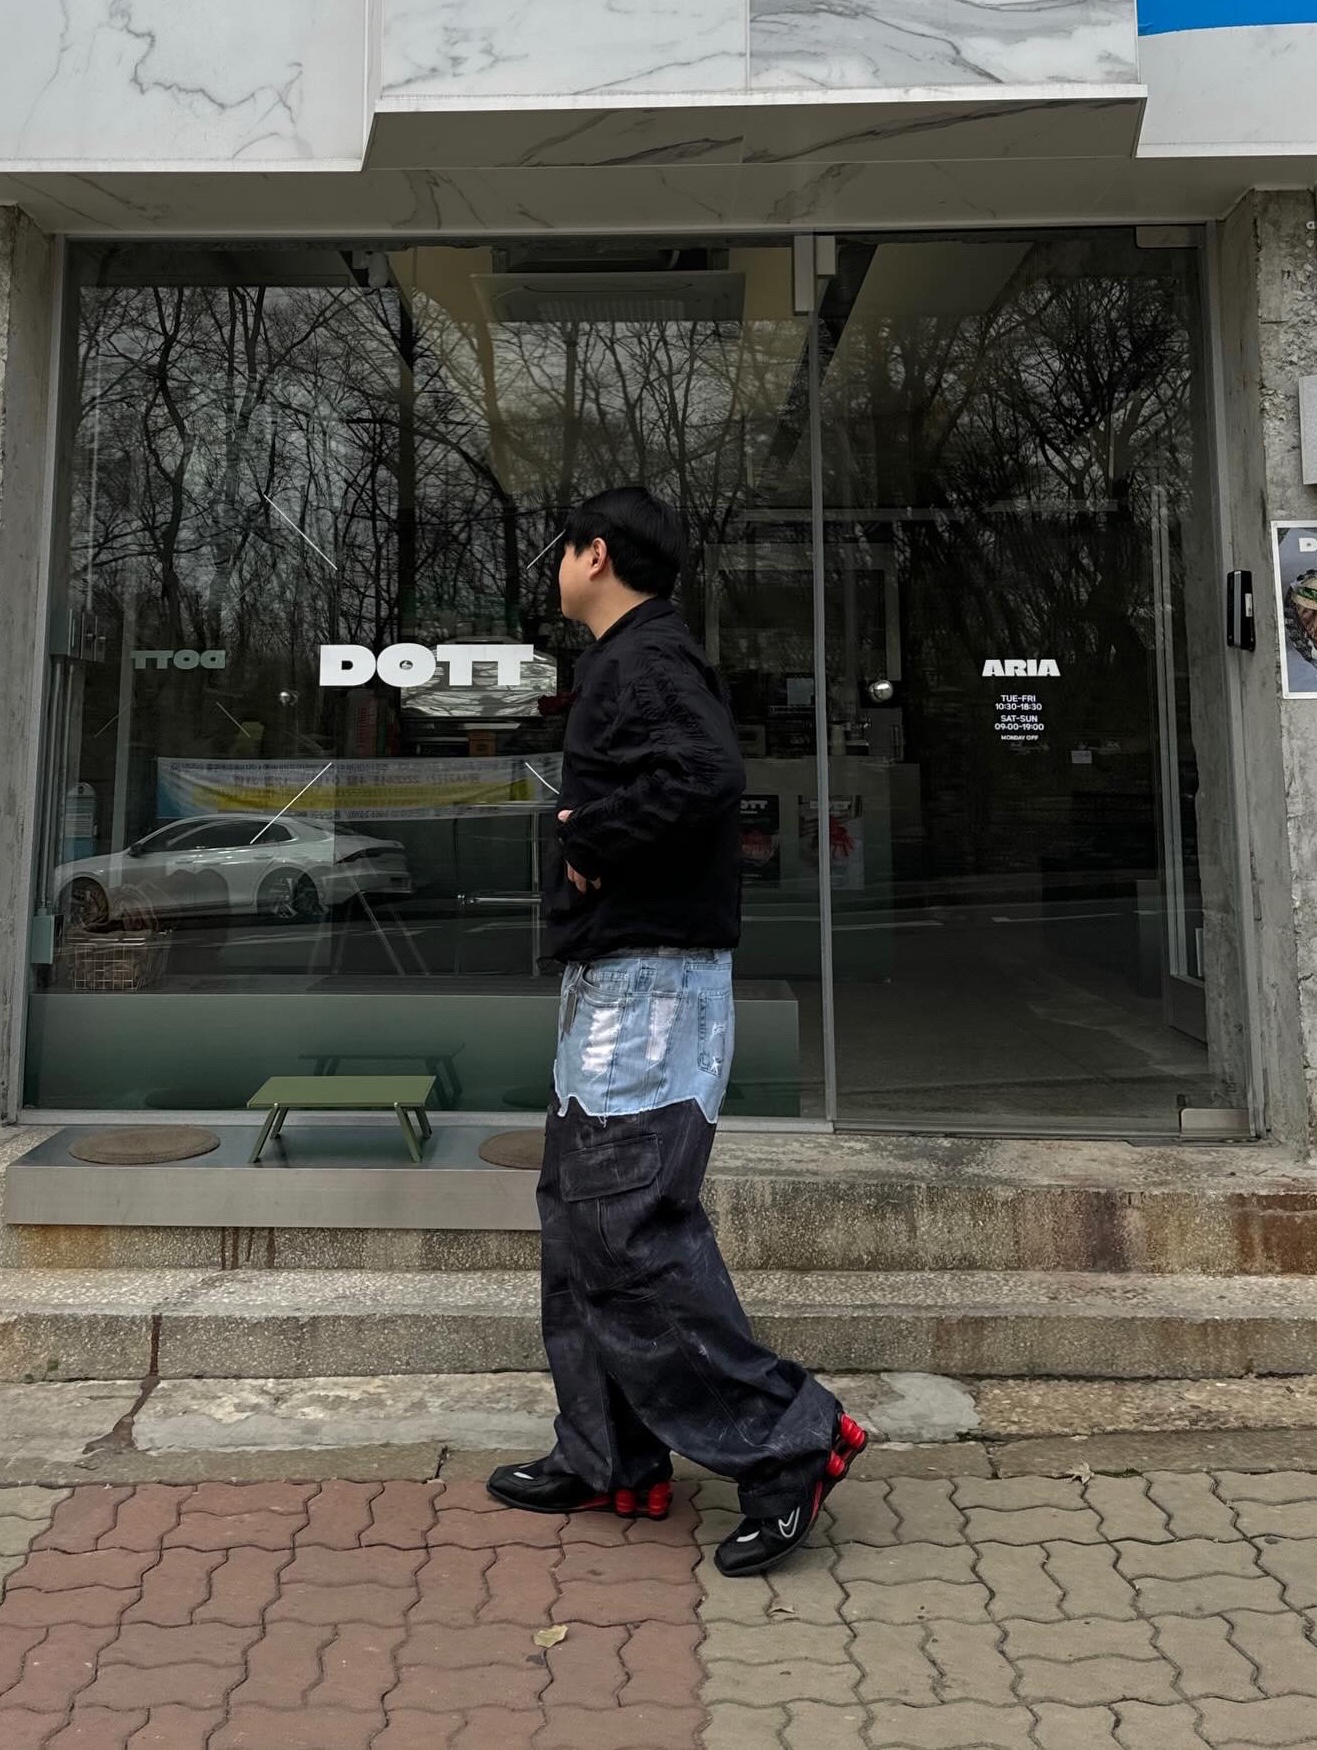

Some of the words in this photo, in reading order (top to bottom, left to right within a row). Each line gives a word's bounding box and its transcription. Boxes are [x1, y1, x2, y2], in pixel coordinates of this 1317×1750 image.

[319, 643, 534, 687] DOTT
[982, 659, 1061, 677] ARIA
[1000, 694, 1036, 703] TUE-FRI
[995, 703, 1043, 711] 10:30-18:30
[1000, 715, 1038, 723] SAT-SUN
[740, 800, 768, 809] OTT
